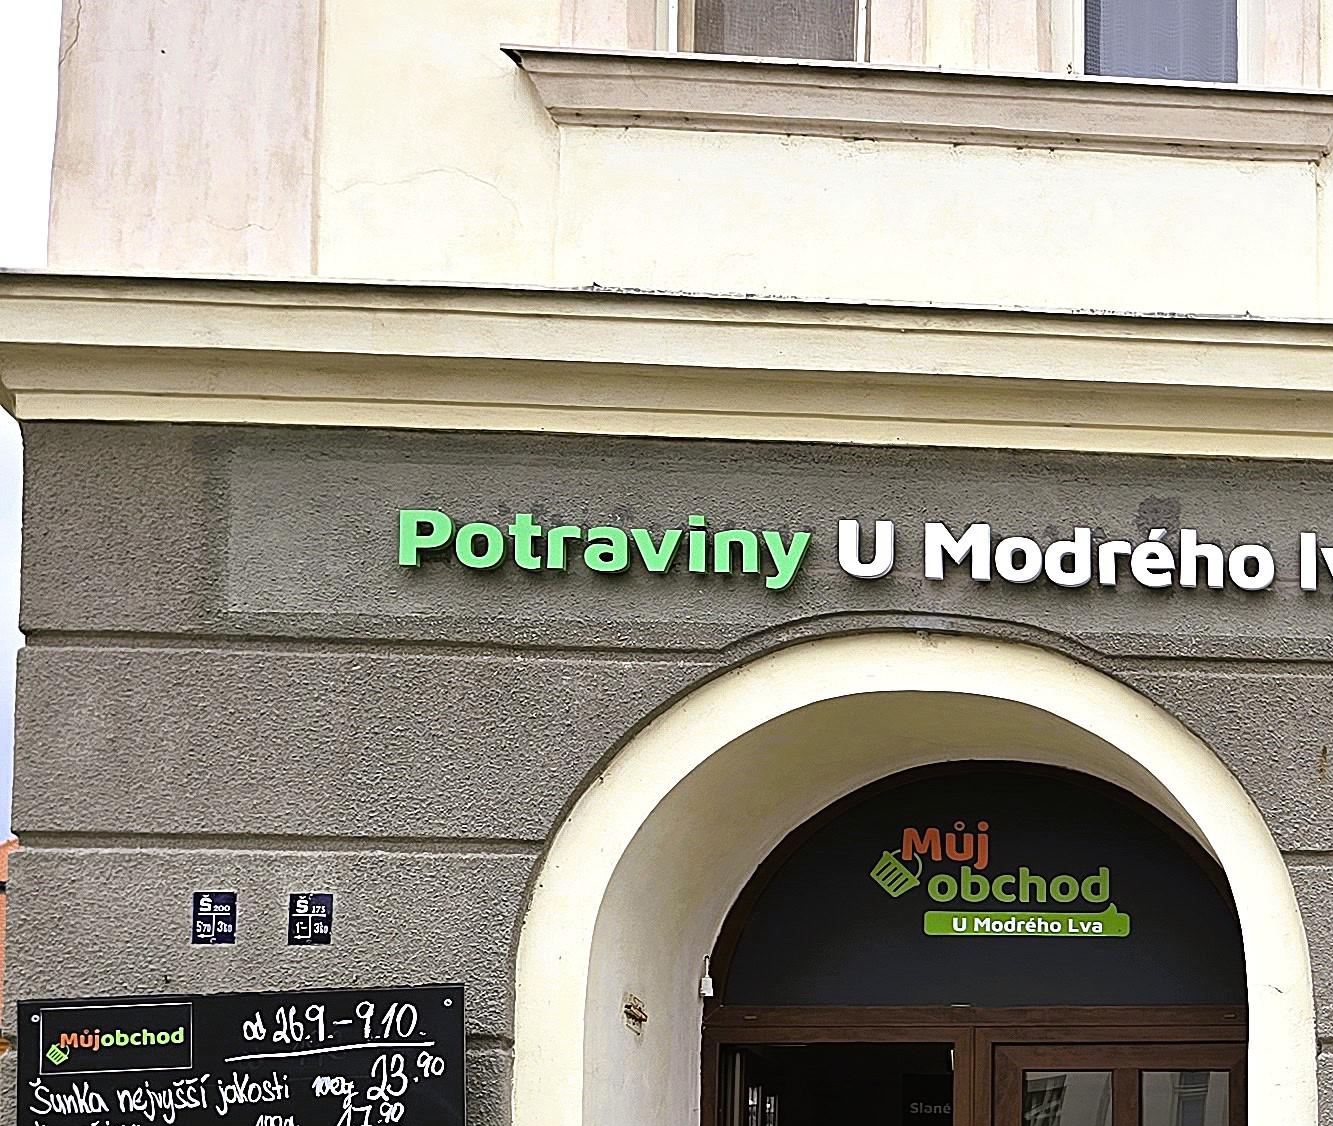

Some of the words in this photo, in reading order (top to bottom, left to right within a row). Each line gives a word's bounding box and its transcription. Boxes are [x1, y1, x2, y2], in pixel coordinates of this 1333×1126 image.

[399, 509, 811, 590] Potraviny
[838, 519, 894, 579] U
[924, 521, 1275, 591] Modrého
[902, 821, 989, 869] Můj
[928, 866, 1110, 903] obchod
[200, 894, 212, 911] Š
[296, 896, 308, 913] Š
[953, 918, 967, 932] U
[974, 918, 1062, 933] Modrého
[1068, 919, 1103, 933] Lva
[243, 1012, 266, 1040] od
[29, 1078, 109, 1114] Šunka
[117, 1073, 210, 1124] nejvyšší
[216, 1071, 289, 1115] jakosti
[910, 1102, 951, 1114] Slané
